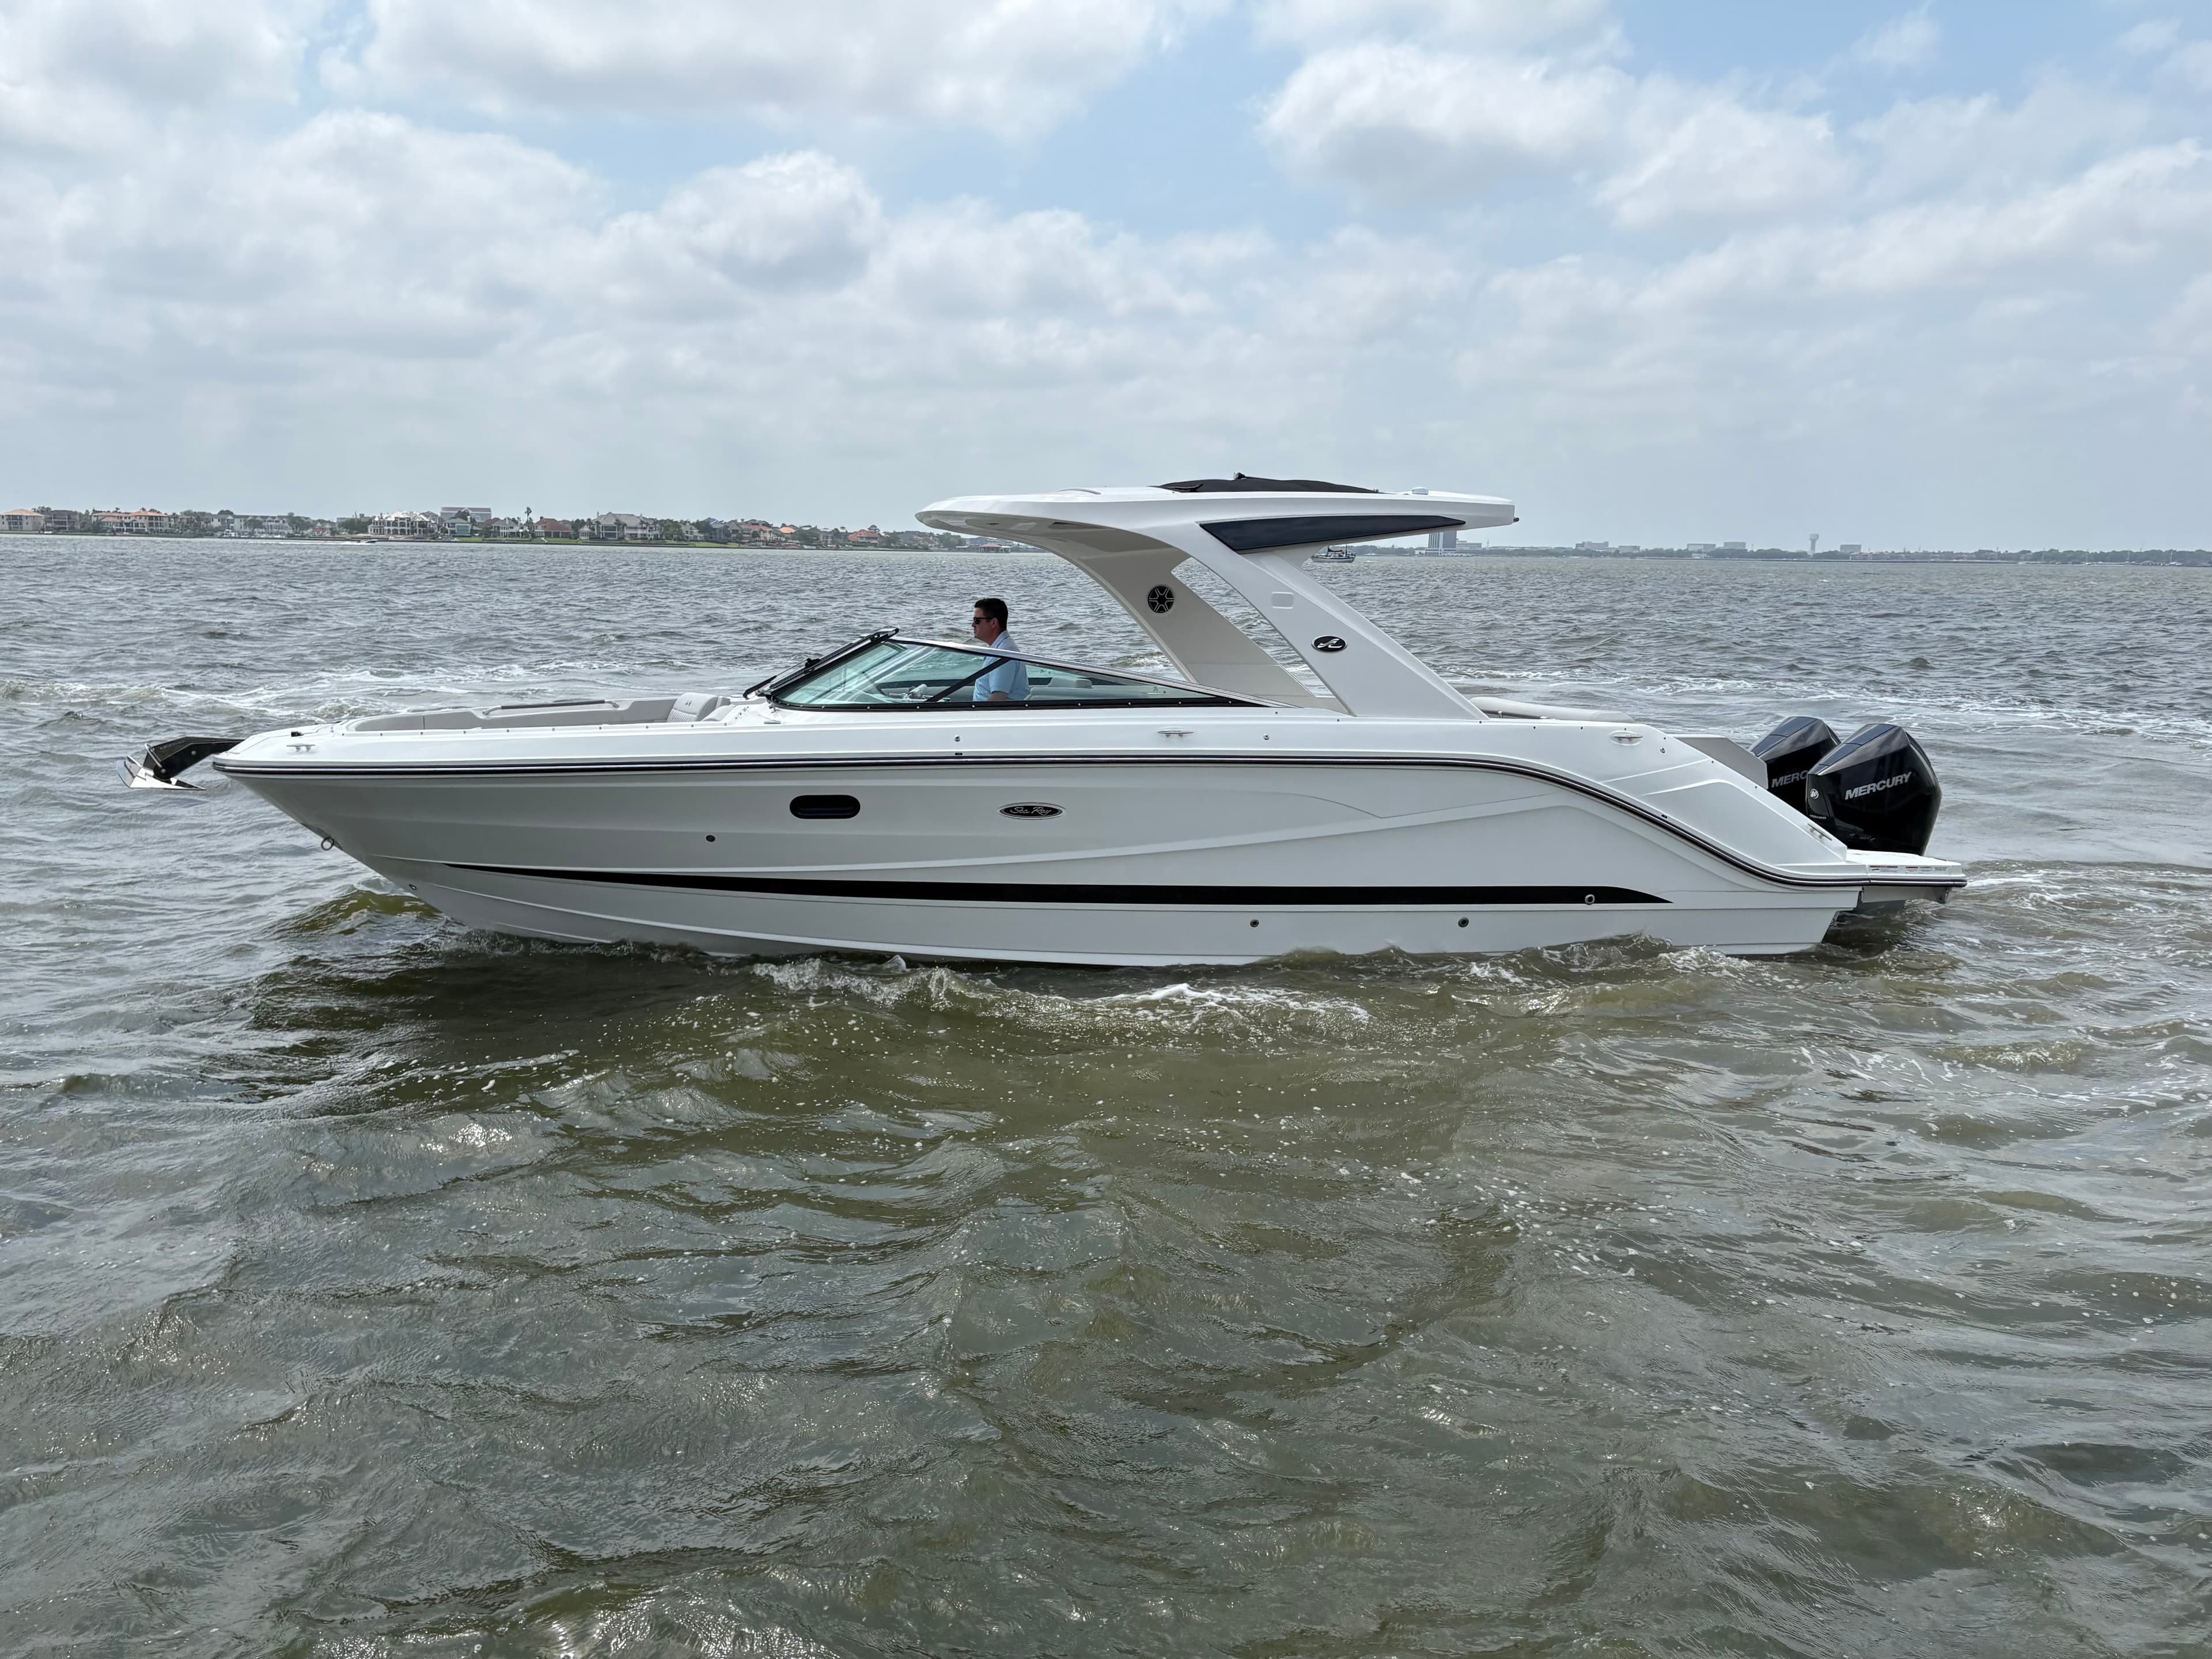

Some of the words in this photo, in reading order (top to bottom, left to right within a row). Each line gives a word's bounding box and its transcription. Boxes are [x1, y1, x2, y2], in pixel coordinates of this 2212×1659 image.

[1771, 770, 1808, 788] MERC
[1844, 771, 1912, 800] MERCURY
[1031, 806, 1052, 816] Ray
